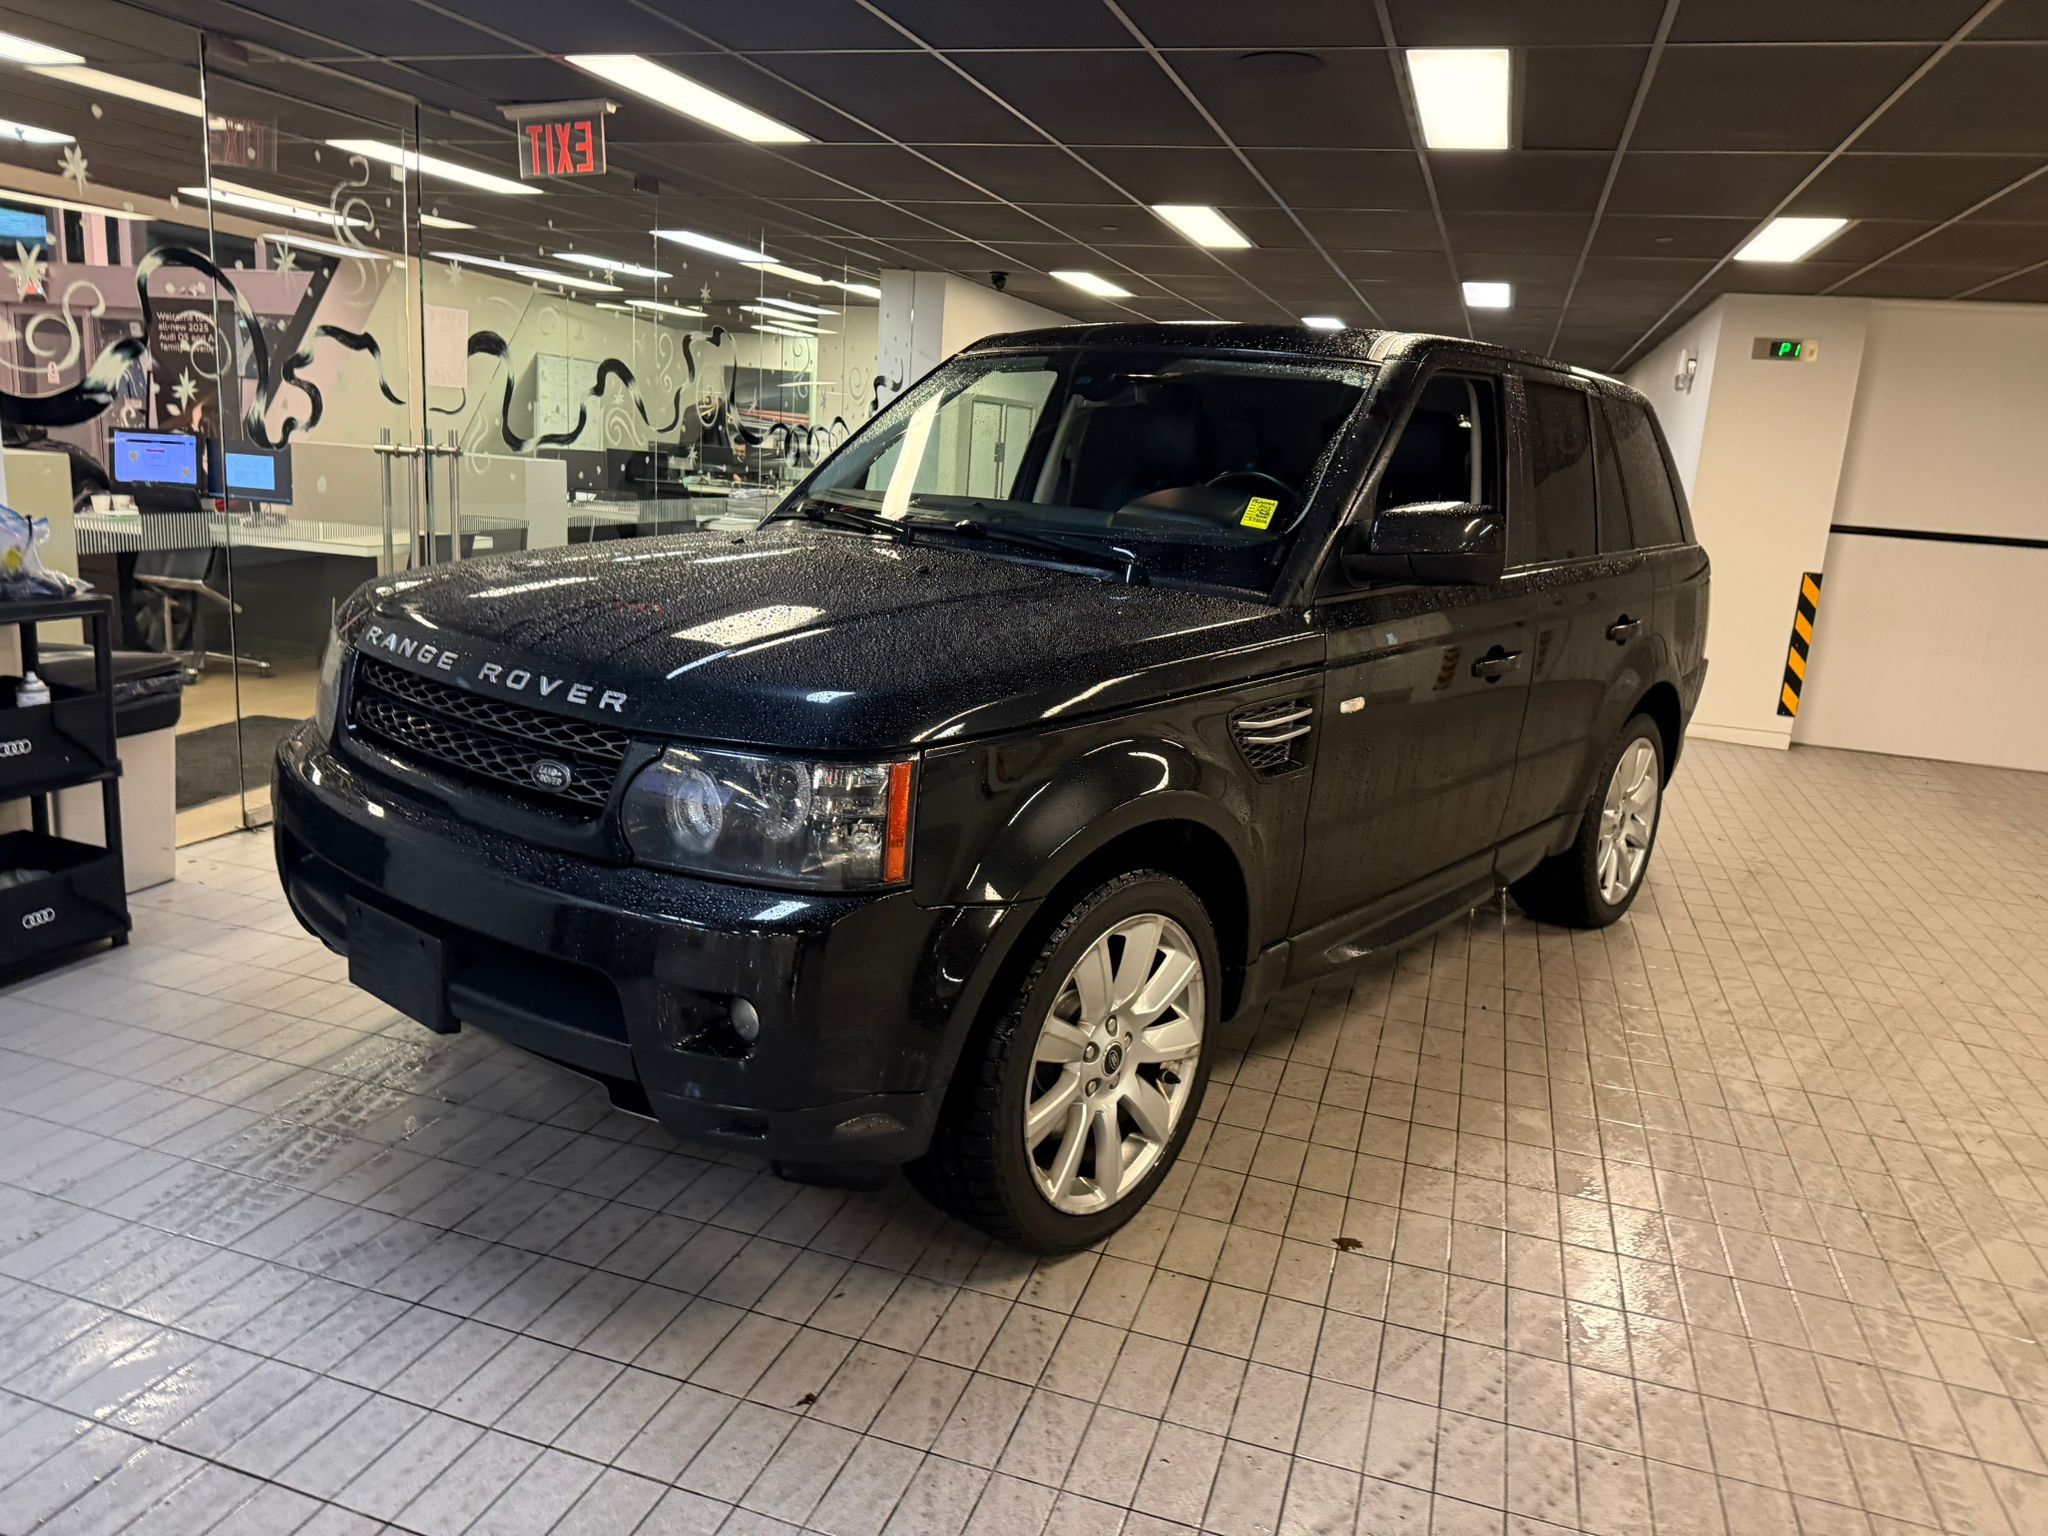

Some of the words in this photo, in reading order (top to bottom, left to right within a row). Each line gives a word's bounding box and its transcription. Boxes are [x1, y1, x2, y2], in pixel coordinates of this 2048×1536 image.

[188, 322, 209, 333] 2025
[159, 333, 177, 342] Audi
[1778, 342, 1801, 358] P1
[365, 625, 459, 671] RANGE
[478, 662, 628, 713] ROVER
